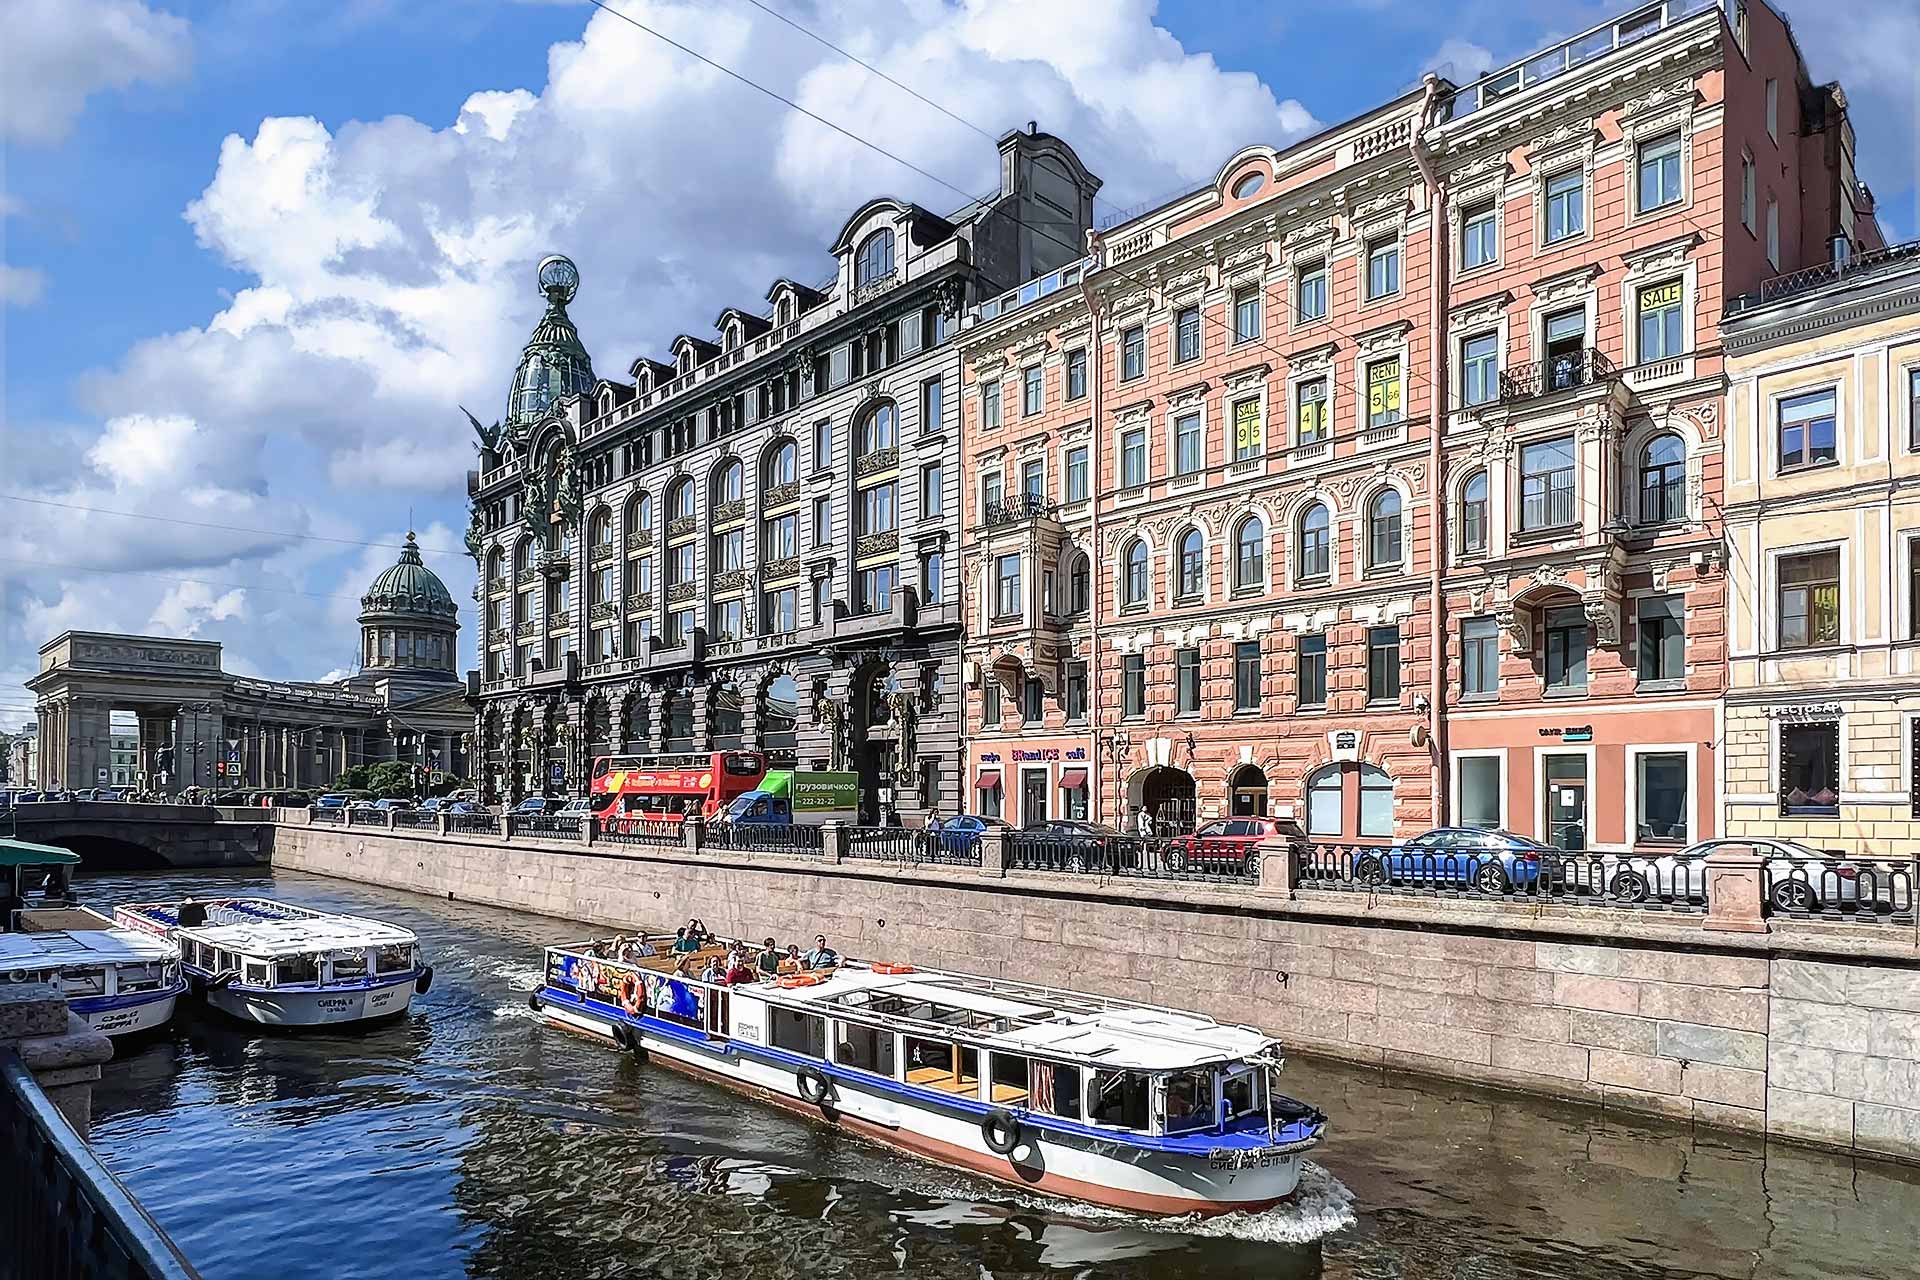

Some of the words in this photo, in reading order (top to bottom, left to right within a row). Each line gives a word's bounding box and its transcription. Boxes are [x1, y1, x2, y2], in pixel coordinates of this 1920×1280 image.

[1643, 285, 1678, 307] SALE
[1371, 360, 1398, 380] RENT
[1372, 392, 1382, 407] 5
[1238, 402, 1260, 418] SALE
[1302, 411, 1311, 424] 4
[1238, 428, 1247, 442] 9
[1252, 425, 1260, 438] 5
[1775, 701, 1840, 717] РЕСТОБАР
[1228, 1174, 1237, 1185] 7
